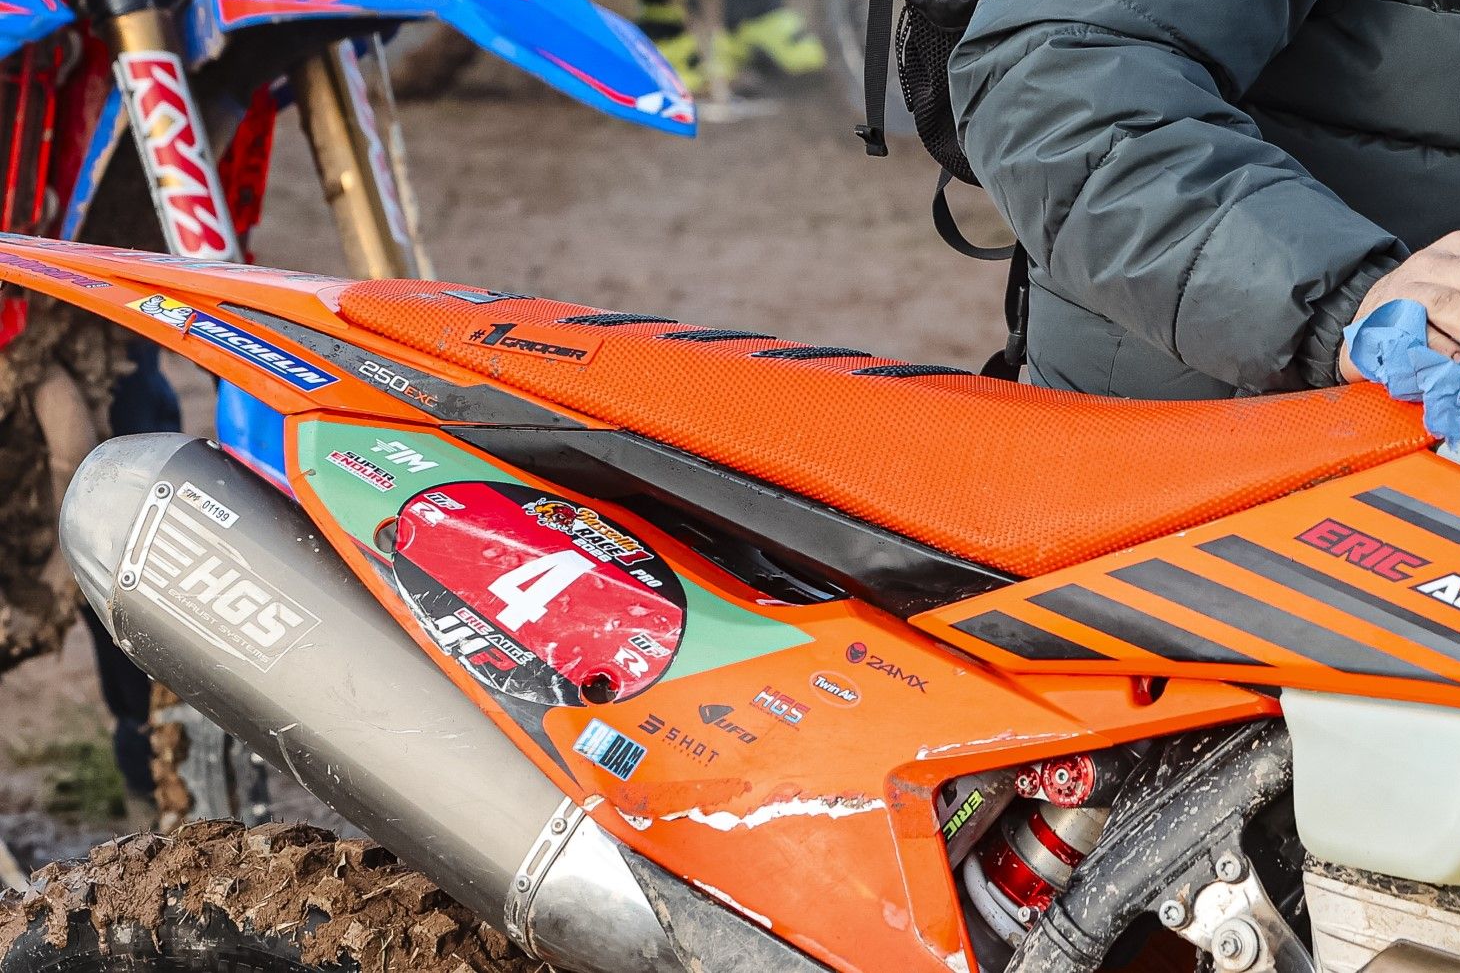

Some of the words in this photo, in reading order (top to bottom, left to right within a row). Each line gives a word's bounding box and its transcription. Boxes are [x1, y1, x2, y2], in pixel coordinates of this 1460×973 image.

[129, 60, 227, 252] KYB
[194, 319, 329, 385] MICHELIN
[500, 336, 588, 361] GRIPPER
[330, 452, 394, 490] ENDURO
[344, 451, 396, 481] SUPER
[370, 438, 439, 473] FIM
[201, 500, 230, 522] 01199
[576, 527, 627, 559] RACE
[1294, 518, 1433, 582] ERIC
[487, 549, 597, 633] 4
[629, 569, 664, 588] PRO
[177, 556, 304, 647] HGS
[168, 588, 218, 625] EXHAUST
[217, 624, 271, 664] SYSTEMS
[454, 607, 490, 635] ERIC
[866, 655, 929, 694] 24MX
[752, 685, 811, 725] HGS
[664, 727, 720, 763] SHOT
[713, 718, 758, 744] UFO
[942, 788, 985, 841] ERIC
